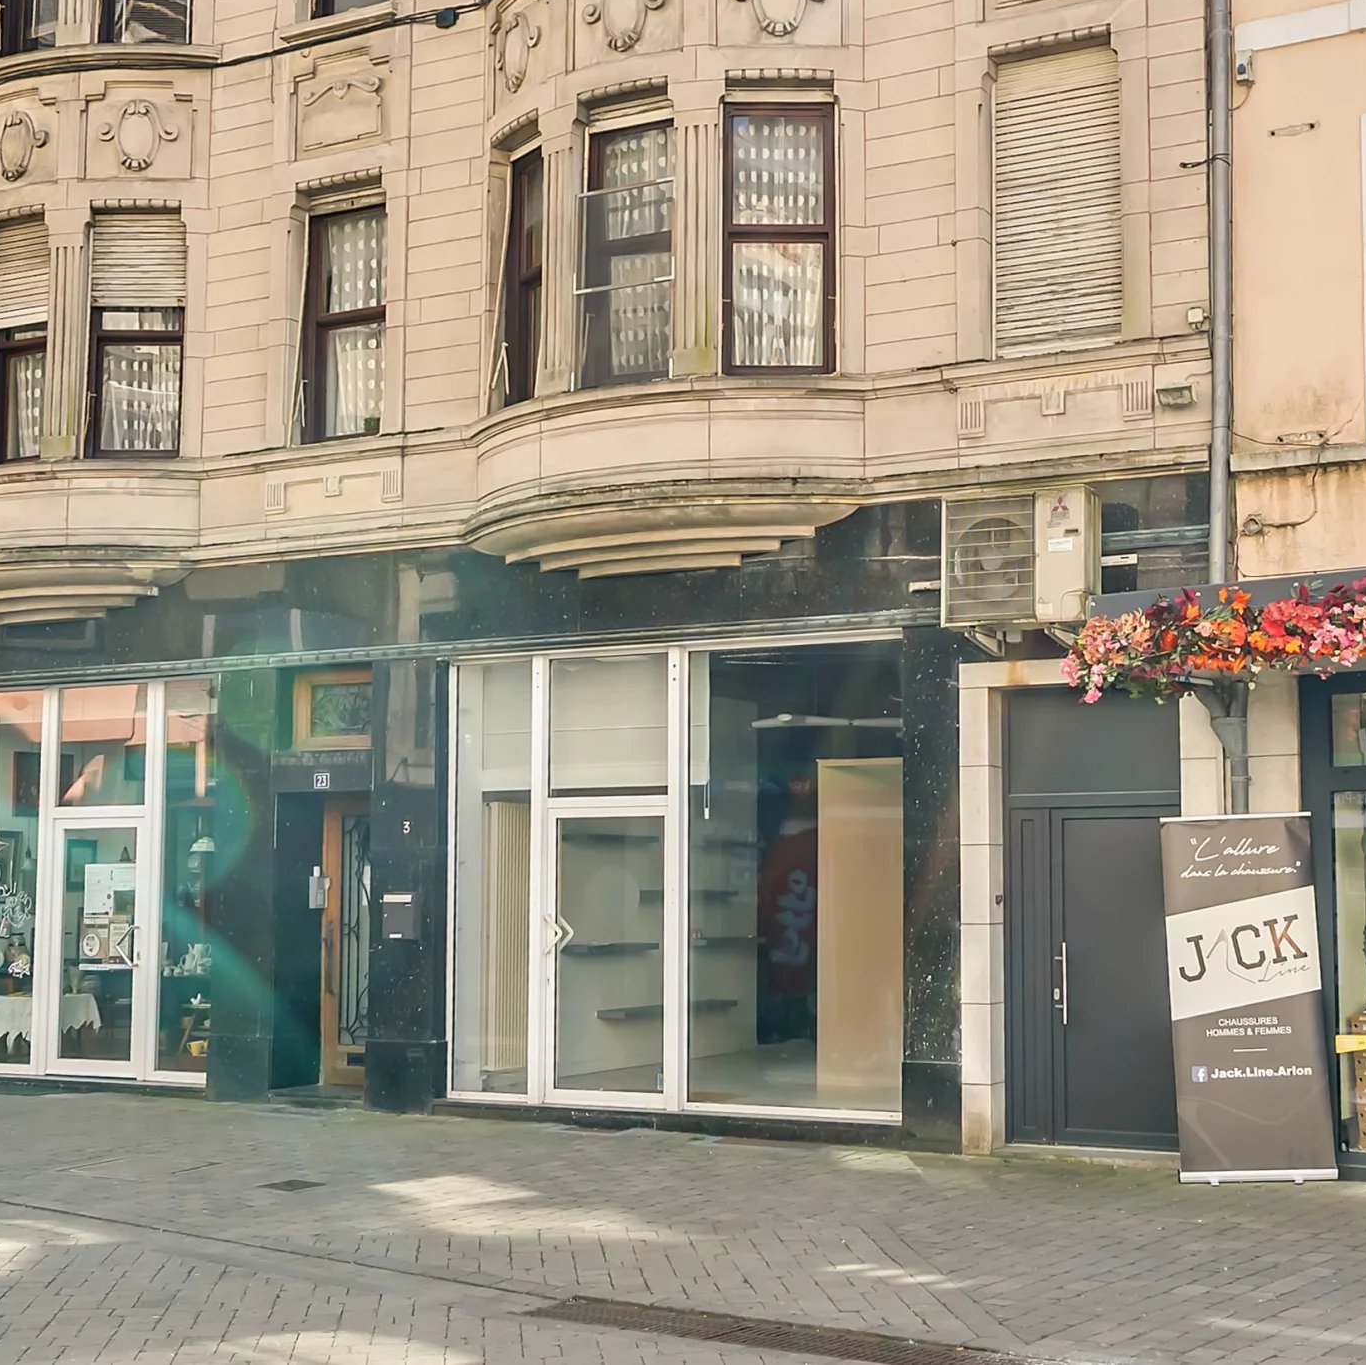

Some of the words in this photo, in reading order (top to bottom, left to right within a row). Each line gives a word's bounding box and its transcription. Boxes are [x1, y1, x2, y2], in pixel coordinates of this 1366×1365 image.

[316, 775, 327, 787] 23
[402, 821, 411, 834] 3
[1180, 864, 1213, 879] dans
[1214, 863, 1229, 878] la
[1258, 960, 1311, 983] Line
[1218, 1016, 1278, 1027] CHAUSSURES
[1206, 1027, 1245, 1037] HOMMES
[1246, 1027, 1254, 1036] &
[1255, 1025, 1292, 1036] FEMMES
[1210, 1065, 1313, 1079] Jack.Line.Arlon
